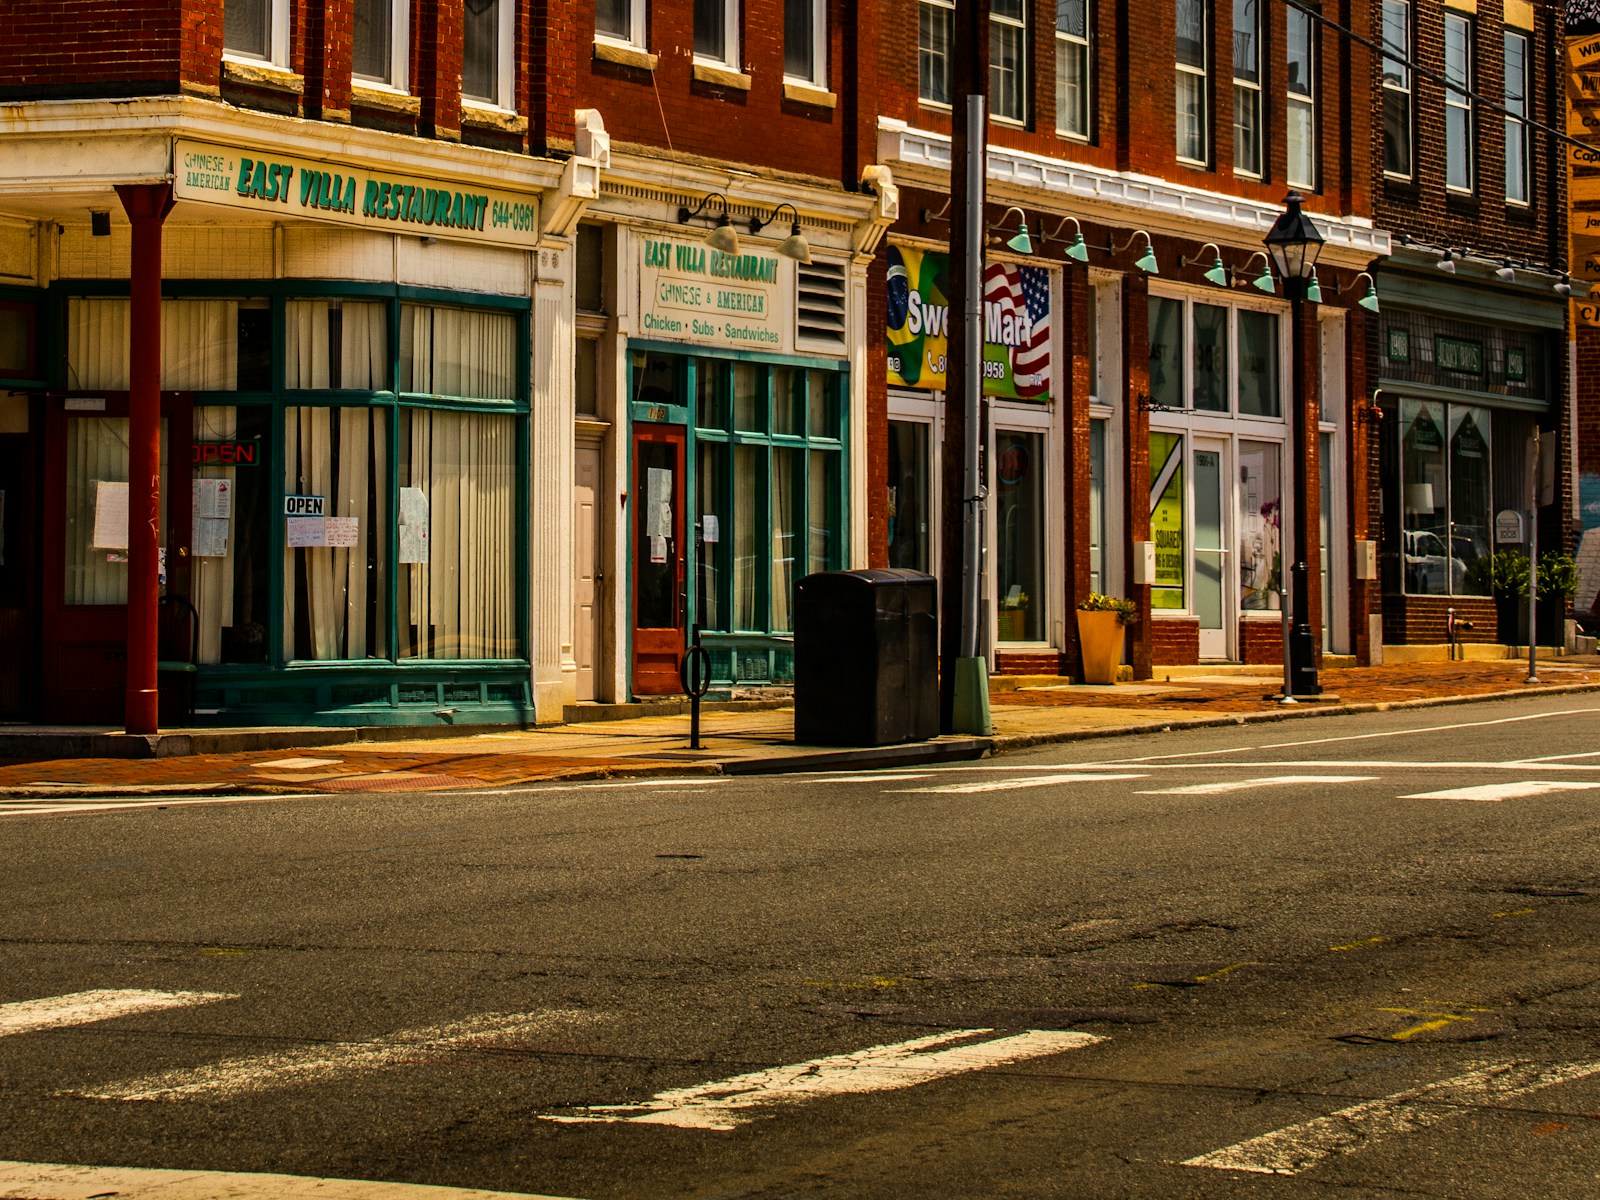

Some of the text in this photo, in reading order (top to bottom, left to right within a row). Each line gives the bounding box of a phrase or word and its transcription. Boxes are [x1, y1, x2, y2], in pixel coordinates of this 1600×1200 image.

[184, 152, 233, 173] CHINESE &
[1573, 149, 1600, 164] Cap
[186, 172, 231, 191] AMERICAN
[237, 157, 534, 232] EAST VILLA RESTAURANT 644-0961
[645, 240, 778, 285] EAST VILLA RESTAURANT
[660, 283, 764, 313] CHINESE & AMERICAN
[644, 313, 779, 343] Chicken Subs Sandwiches
[984, 300, 1033, 348] Mart
[287, 497, 323, 514] OPEN
